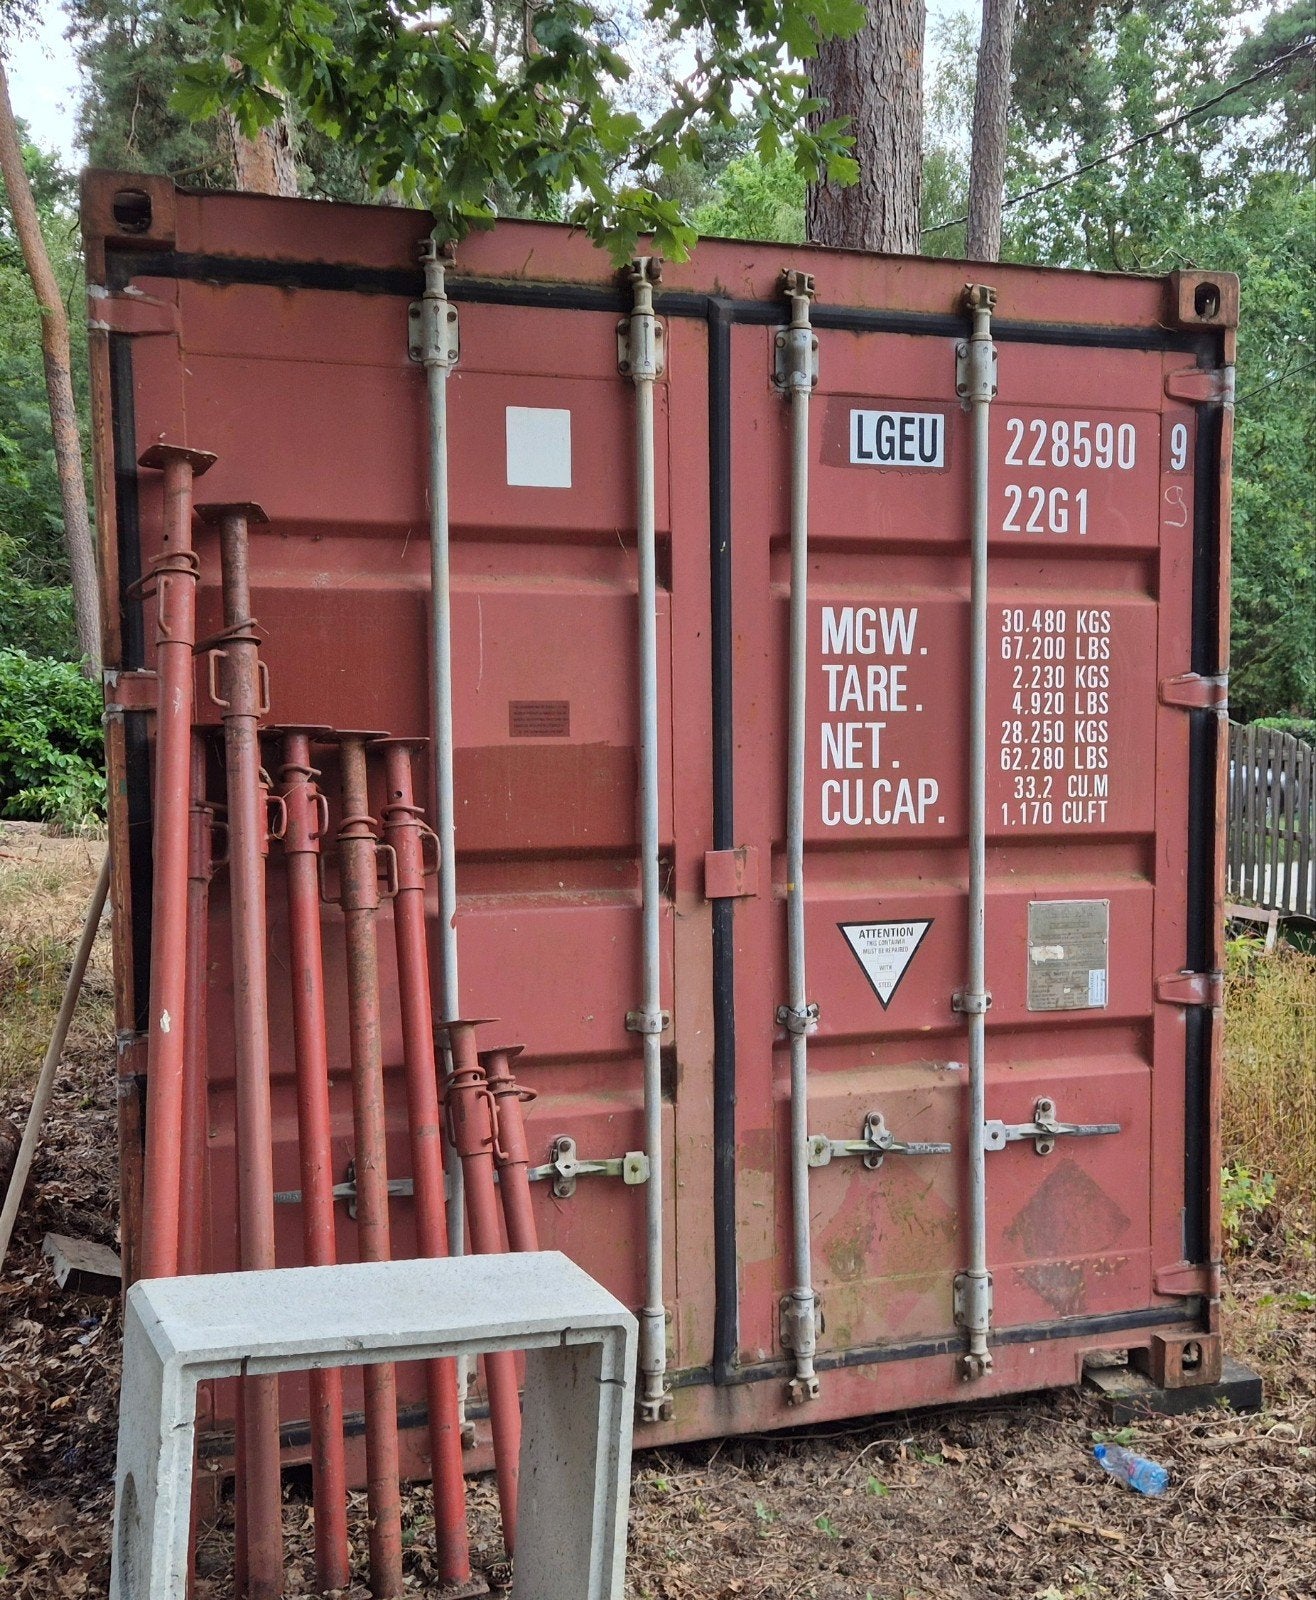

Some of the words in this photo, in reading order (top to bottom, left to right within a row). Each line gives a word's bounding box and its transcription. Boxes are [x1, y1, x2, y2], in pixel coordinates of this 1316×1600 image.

[856, 414, 938, 463] LGEU
[1005, 418, 1135, 469] 228590
[1170, 423, 1188, 470] 9
[1002, 484, 1088, 534] 22G1
[822, 606, 928, 655] MGW.
[1001, 609, 1066, 633] 30,480
[1076, 610, 1111, 633] KGS
[1001, 636, 1066, 659] 67,200
[1075, 637, 1110, 659] LBS
[1012, 665, 1065, 688] 2,230
[1075, 665, 1110, 688] KGS
[1012, 691, 1064, 715] 4,920
[1074, 691, 1109, 715] LBS
[1000, 720, 1064, 744] 28,250
[1074, 719, 1109, 743] KGS
[1000, 746, 1064, 770] 62,280
[1074, 746, 1108, 769] LBS
[1013, 775, 1053, 799] 33.2
[1067, 774, 1108, 798] CU.M
[821, 778, 945, 826] CU.CAP.
[1001, 801, 1053, 826] 1,170
[1062, 800, 1108, 824] CU.FT
[859, 927, 914, 938] ATTENTION
